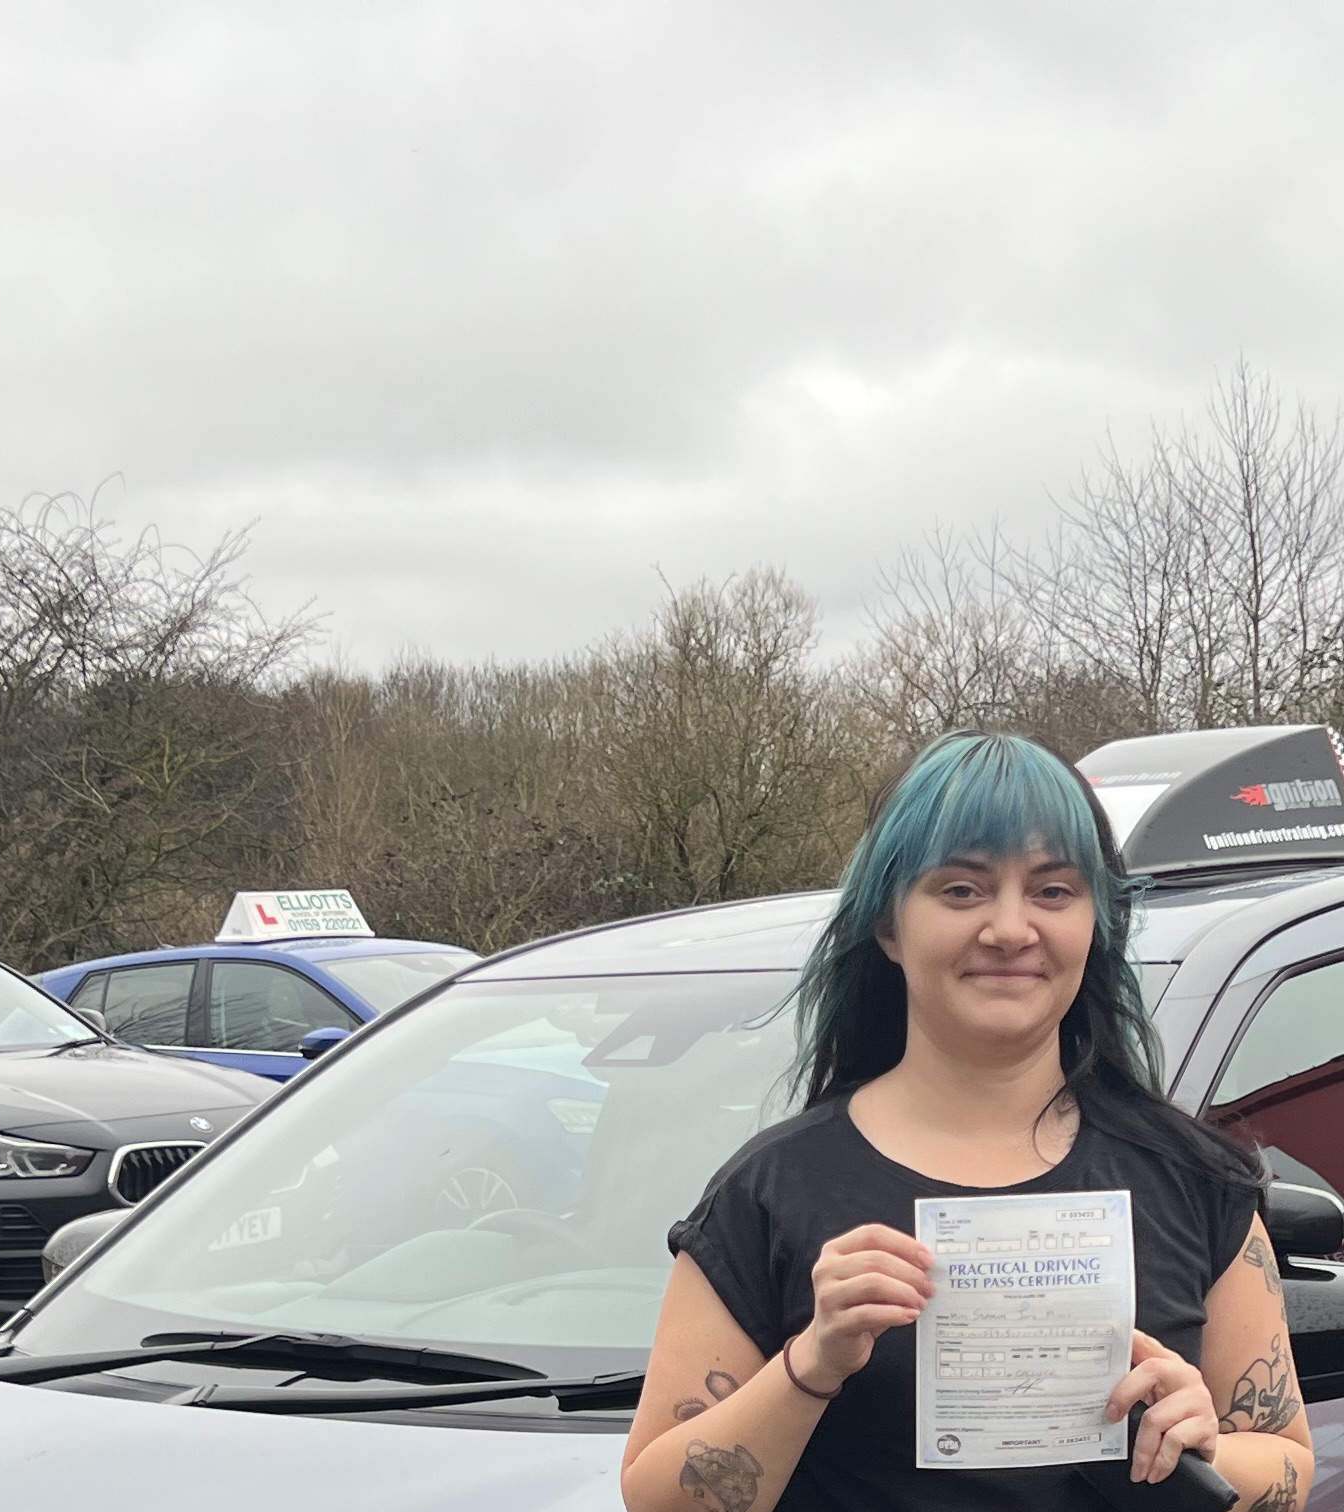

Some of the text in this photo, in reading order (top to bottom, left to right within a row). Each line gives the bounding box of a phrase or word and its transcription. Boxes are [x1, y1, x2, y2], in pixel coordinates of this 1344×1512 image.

[276, 893, 353, 911] ELLIOTTS
[256, 904, 278, 925] L
[288, 916, 364, 932] 01159 220221
[949, 1257, 1100, 1276] PRACTICAL DRIVING
[949, 1273, 1101, 1289] TEST PASS CERTIFICATE
